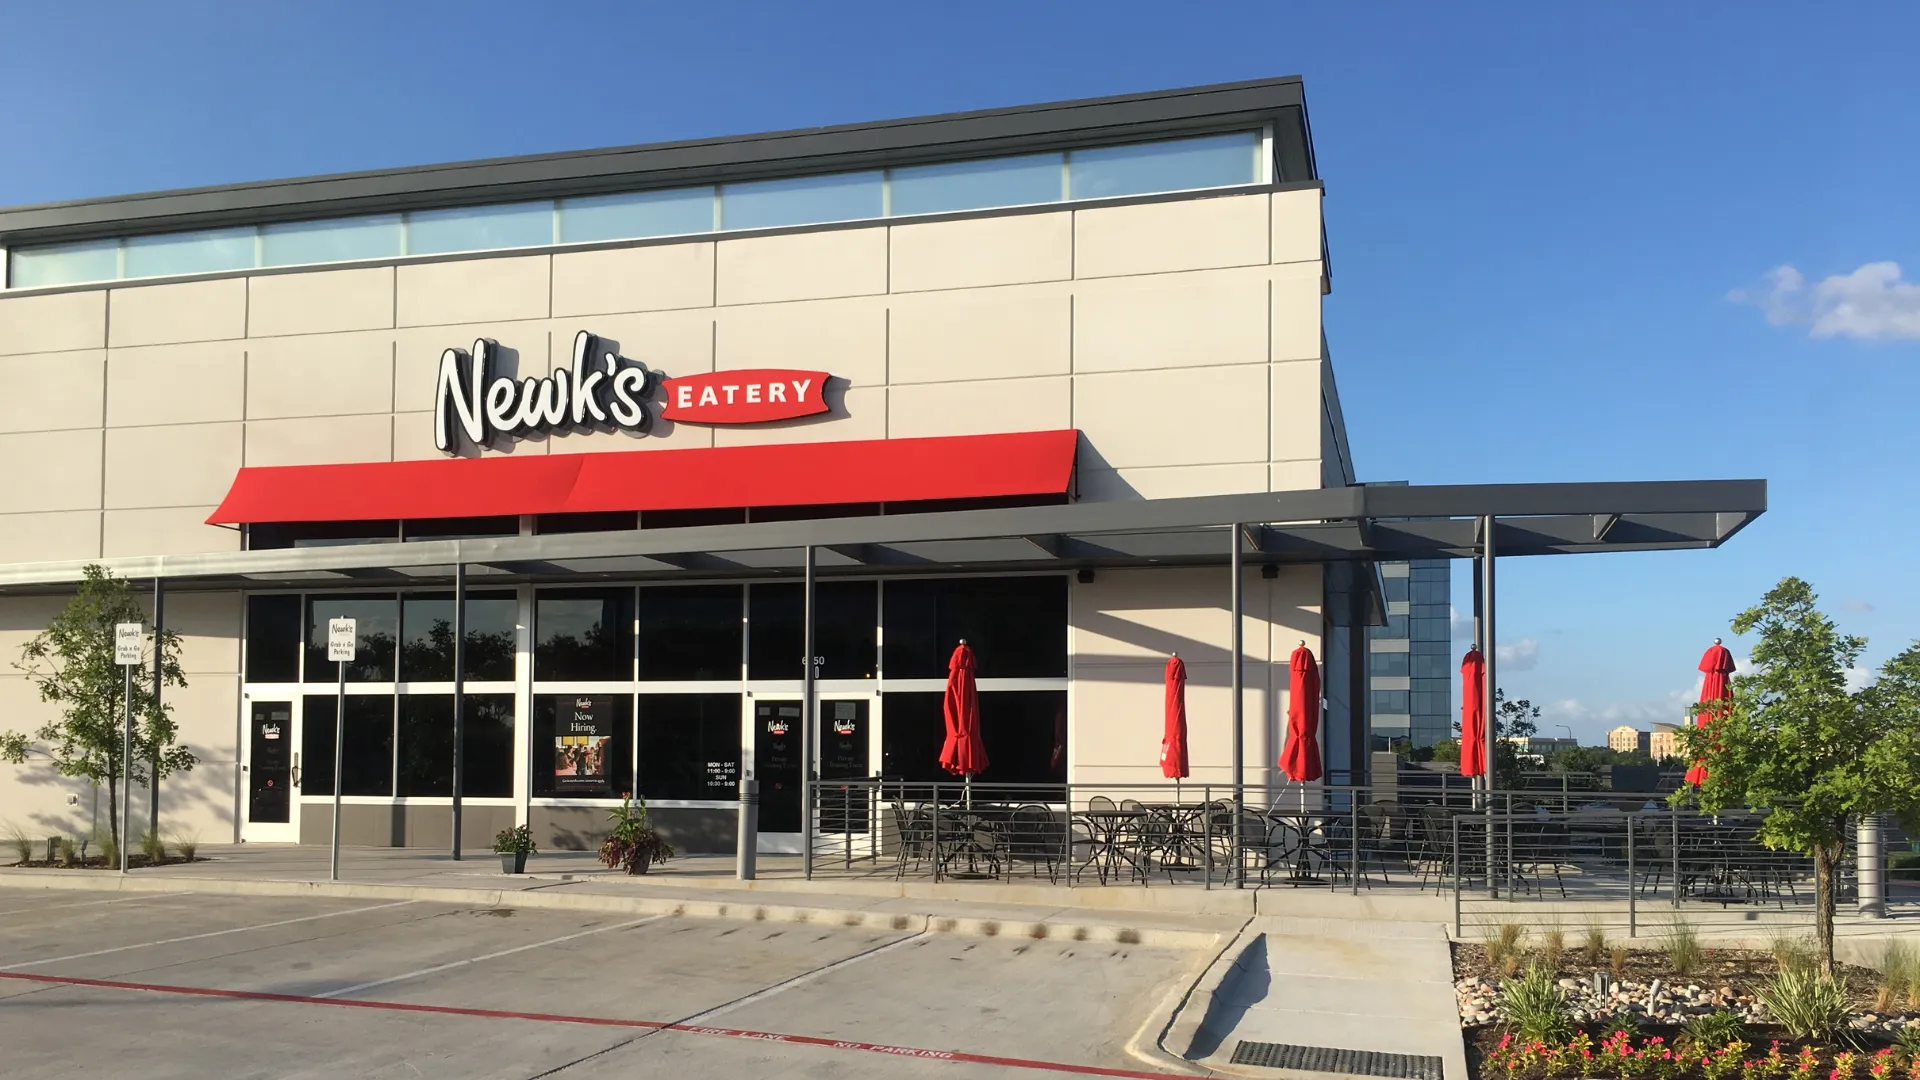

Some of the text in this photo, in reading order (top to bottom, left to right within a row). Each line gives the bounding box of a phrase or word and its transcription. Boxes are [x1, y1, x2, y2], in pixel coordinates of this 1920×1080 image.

[435, 330, 812, 450] Newk's EATERY
[119, 628, 139, 638] Newk's
[332, 623, 352, 634] Newk's
[802, 656, 825, 665] 650
[574, 711, 594, 721] Now
[570, 722, 598, 735] Hiring.
[768, 720, 789, 732] Newk's
[834, 719, 856, 732] Newk's
[688, 1026, 954, 1059] FIRE LANE NO PARKING
